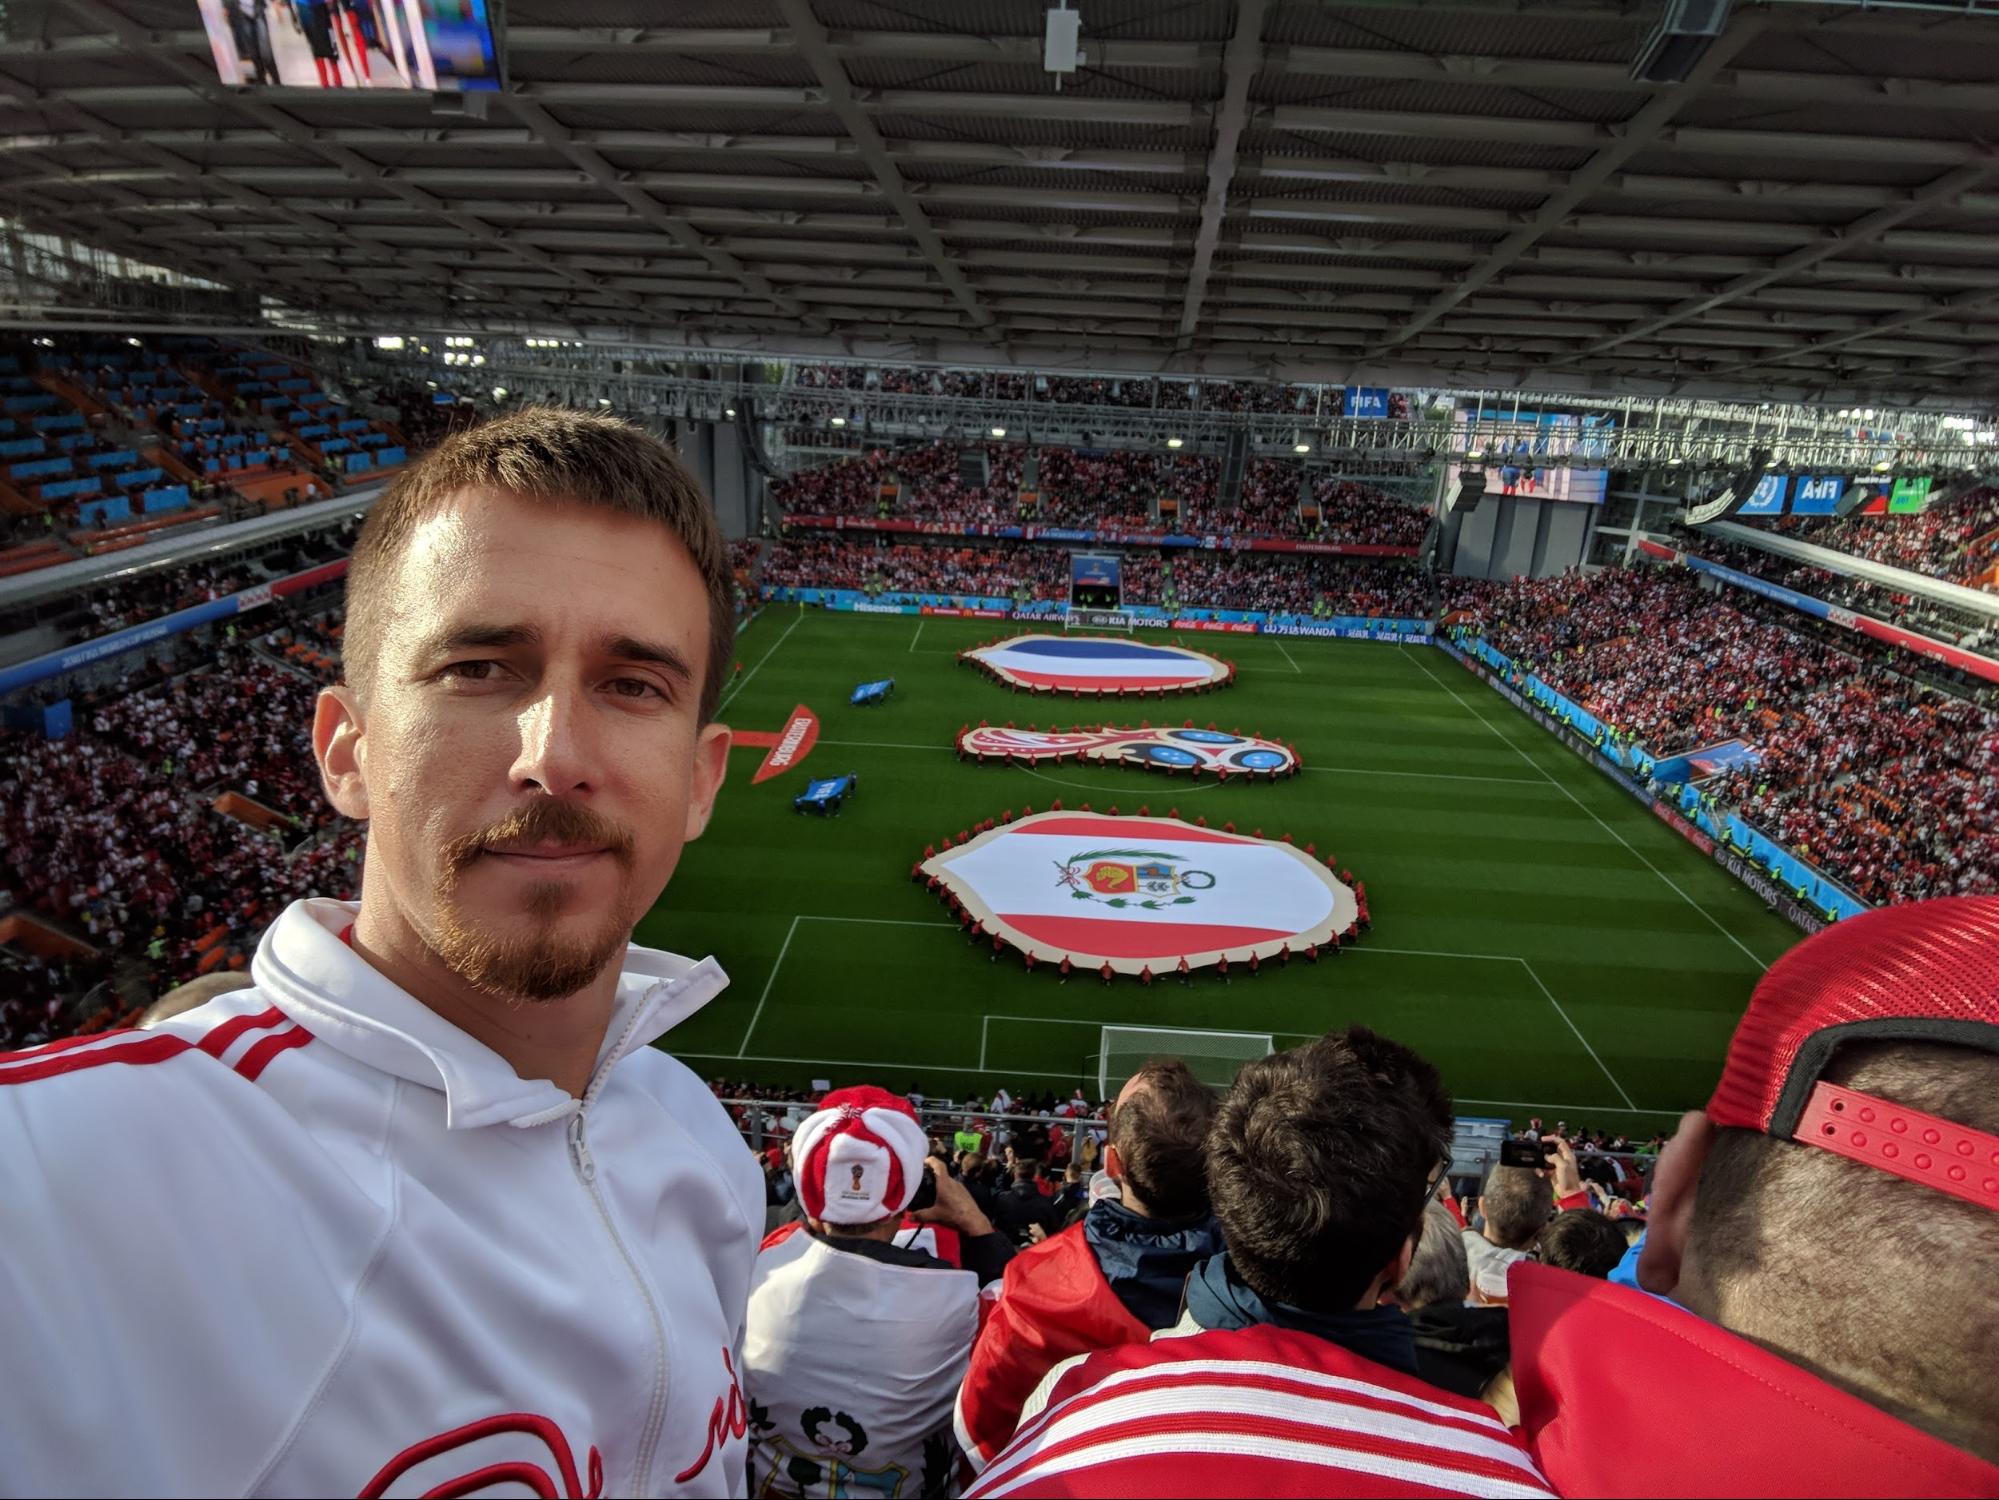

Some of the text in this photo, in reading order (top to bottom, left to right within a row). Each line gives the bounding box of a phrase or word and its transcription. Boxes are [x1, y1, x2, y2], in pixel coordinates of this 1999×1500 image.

[1351, 396, 1382, 408] FIFA
[853, 602, 902, 614] Hisense
[1012, 612, 1080, 622] QATAR AIRWAYS
[1109, 616, 1126, 625] KIA
[1128, 616, 1168, 628] MOTORS
[1299, 626, 1336, 637] WANDA
[1727, 858, 1777, 905] KIA MOTORS
[1788, 906, 1818, 935] QATAR
